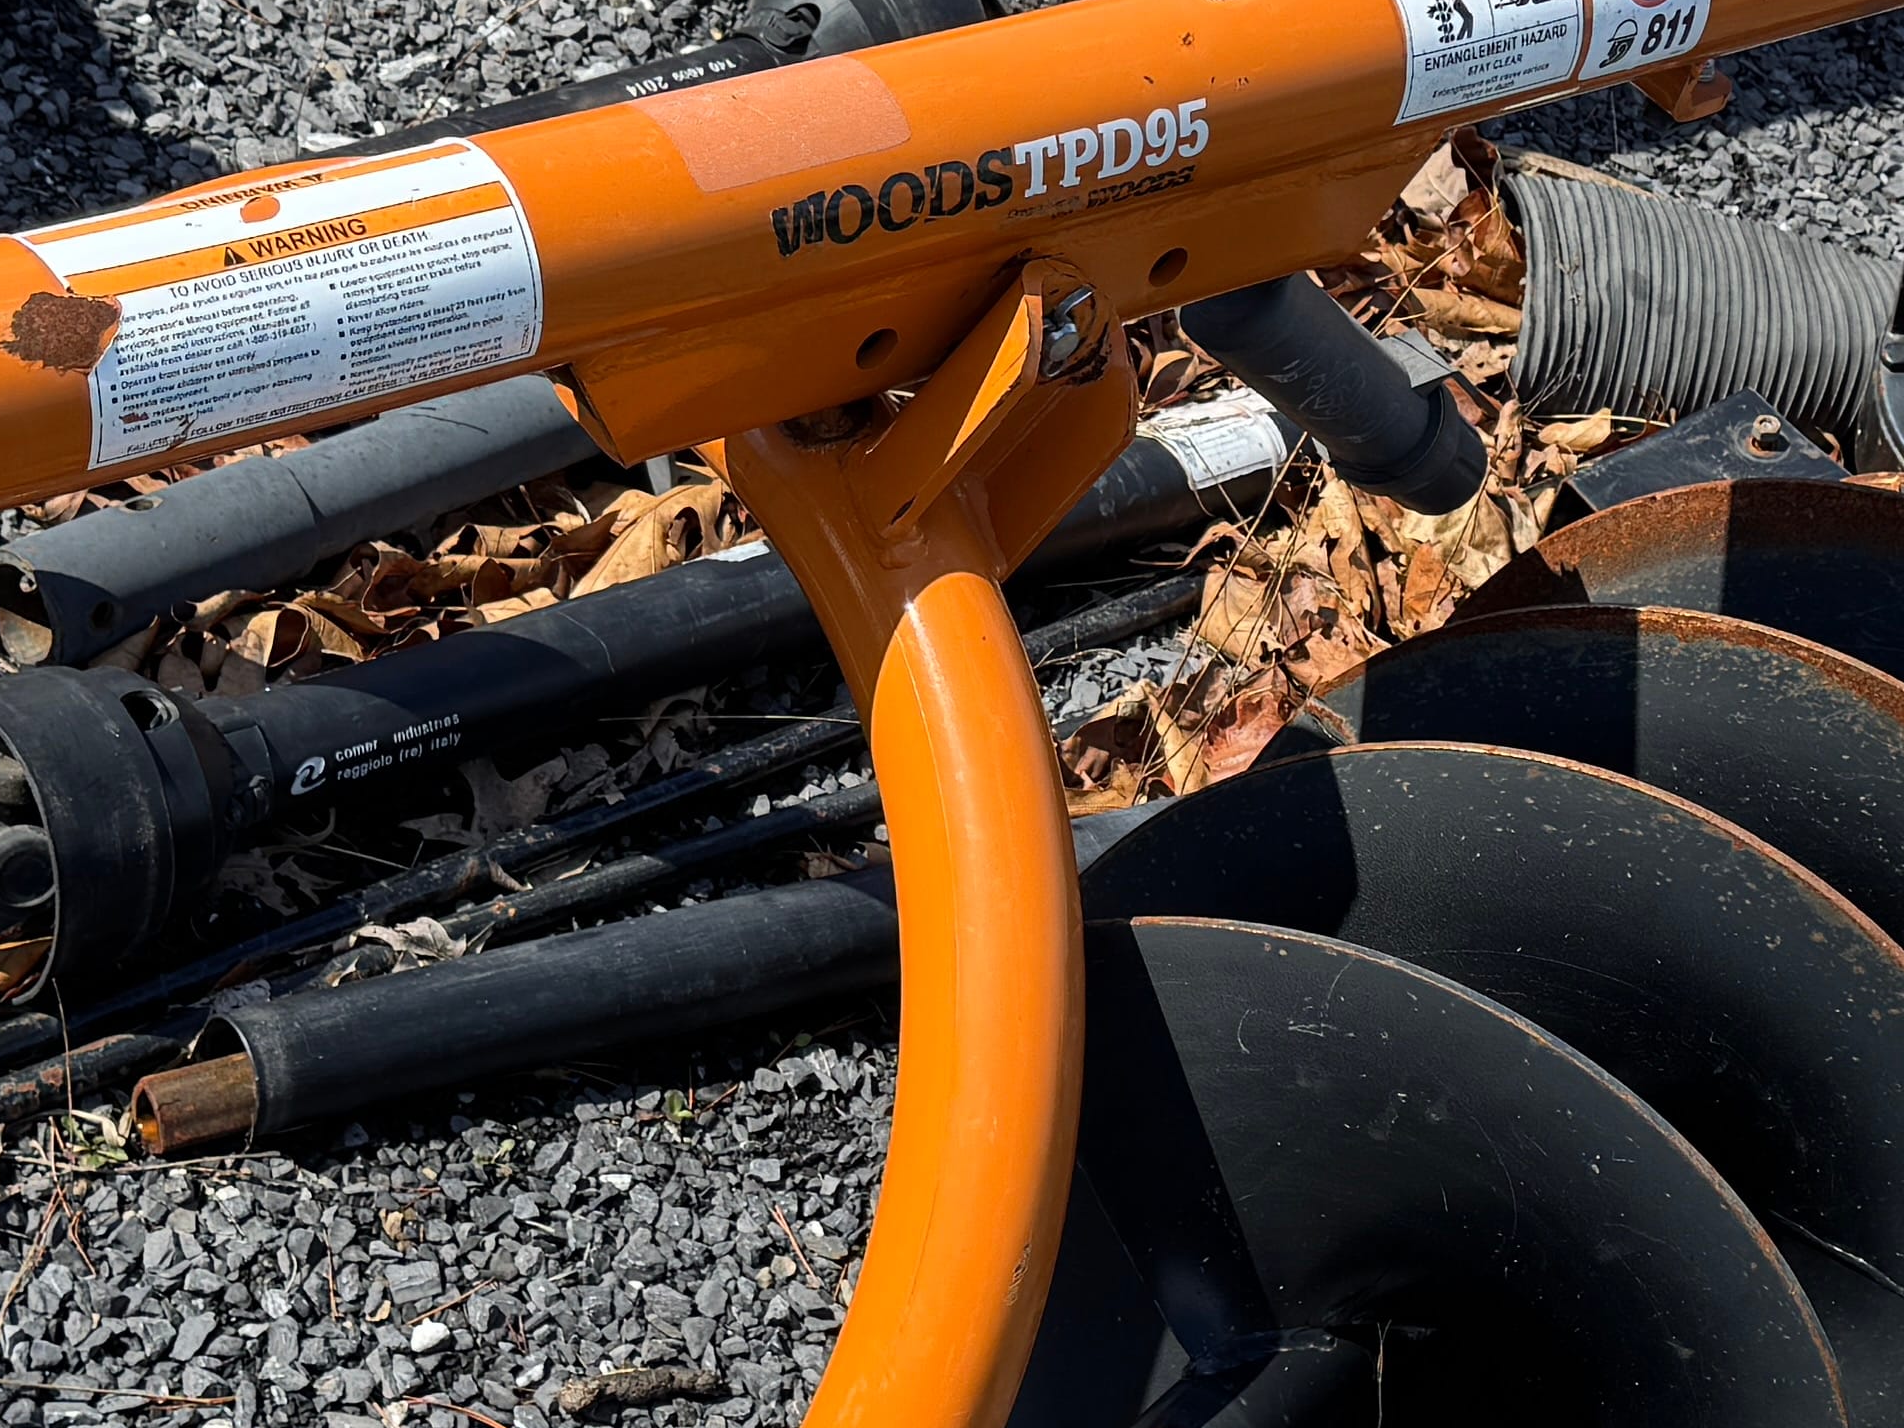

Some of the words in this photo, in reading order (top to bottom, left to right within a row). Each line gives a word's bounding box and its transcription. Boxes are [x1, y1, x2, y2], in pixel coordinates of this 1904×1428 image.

[1424, 35, 1517, 72] ENTANGLEMENT
[1521, 23, 1568, 50] HAZARD
[1641, 6, 1694, 56] 811
[1491, 53, 1523, 69] CLEAR
[625, 74, 669, 98] 2014
[771, 148, 1014, 257] WOODS
[1016, 97, 1209, 198] TPD95
[248, 218, 367, 259] WARNING
[169, 284, 189, 300] TO
[194, 274, 237, 296] AVOID
[240, 259, 303, 285] SERIOUS
[305, 244, 355, 269] INJURY
[359, 239, 380, 256] OR
[335, 739, 378, 762] comer
[393, 713, 460, 744] industries
[337, 753, 393, 780] reggiolo
[430, 732, 462, 751] italy
